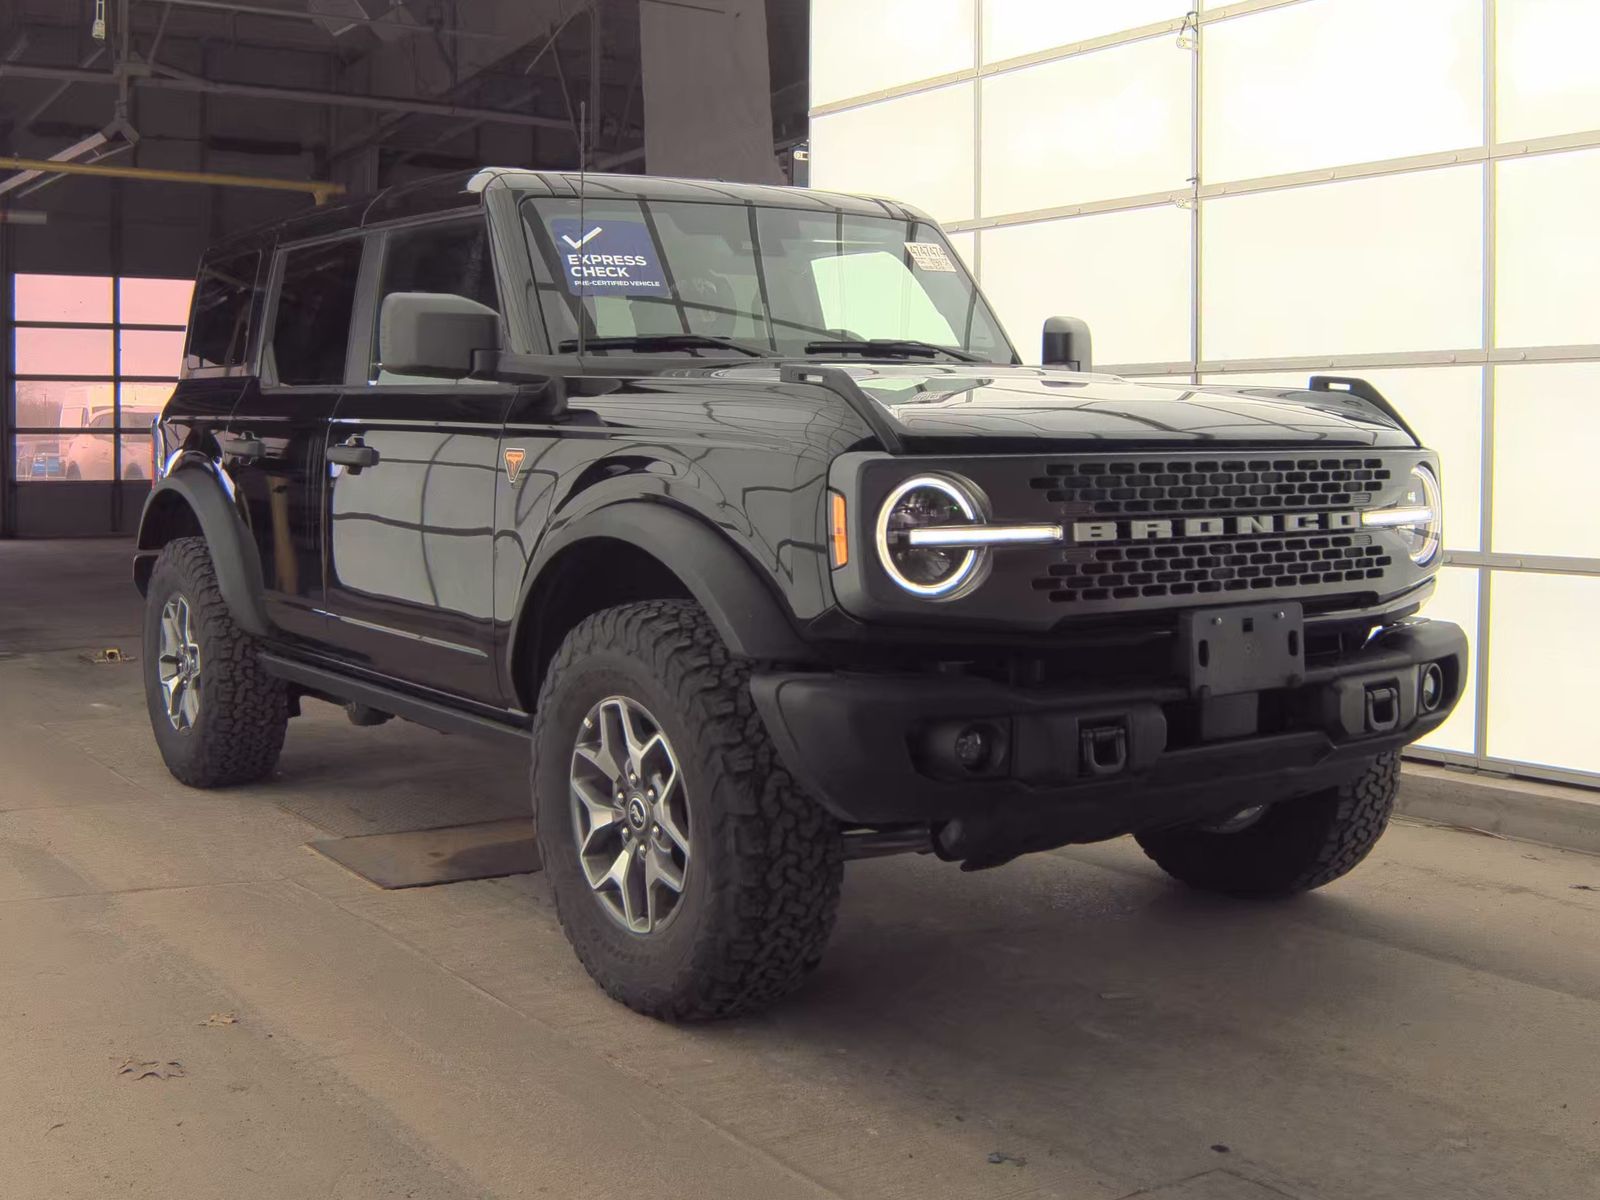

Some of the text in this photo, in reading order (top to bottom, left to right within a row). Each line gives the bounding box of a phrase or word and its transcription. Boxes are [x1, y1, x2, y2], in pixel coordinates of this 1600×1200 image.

[567, 254, 647, 266] EXPRESS
[571, 266, 630, 278] CHECK
[1073, 511, 1361, 542] BRONCO
